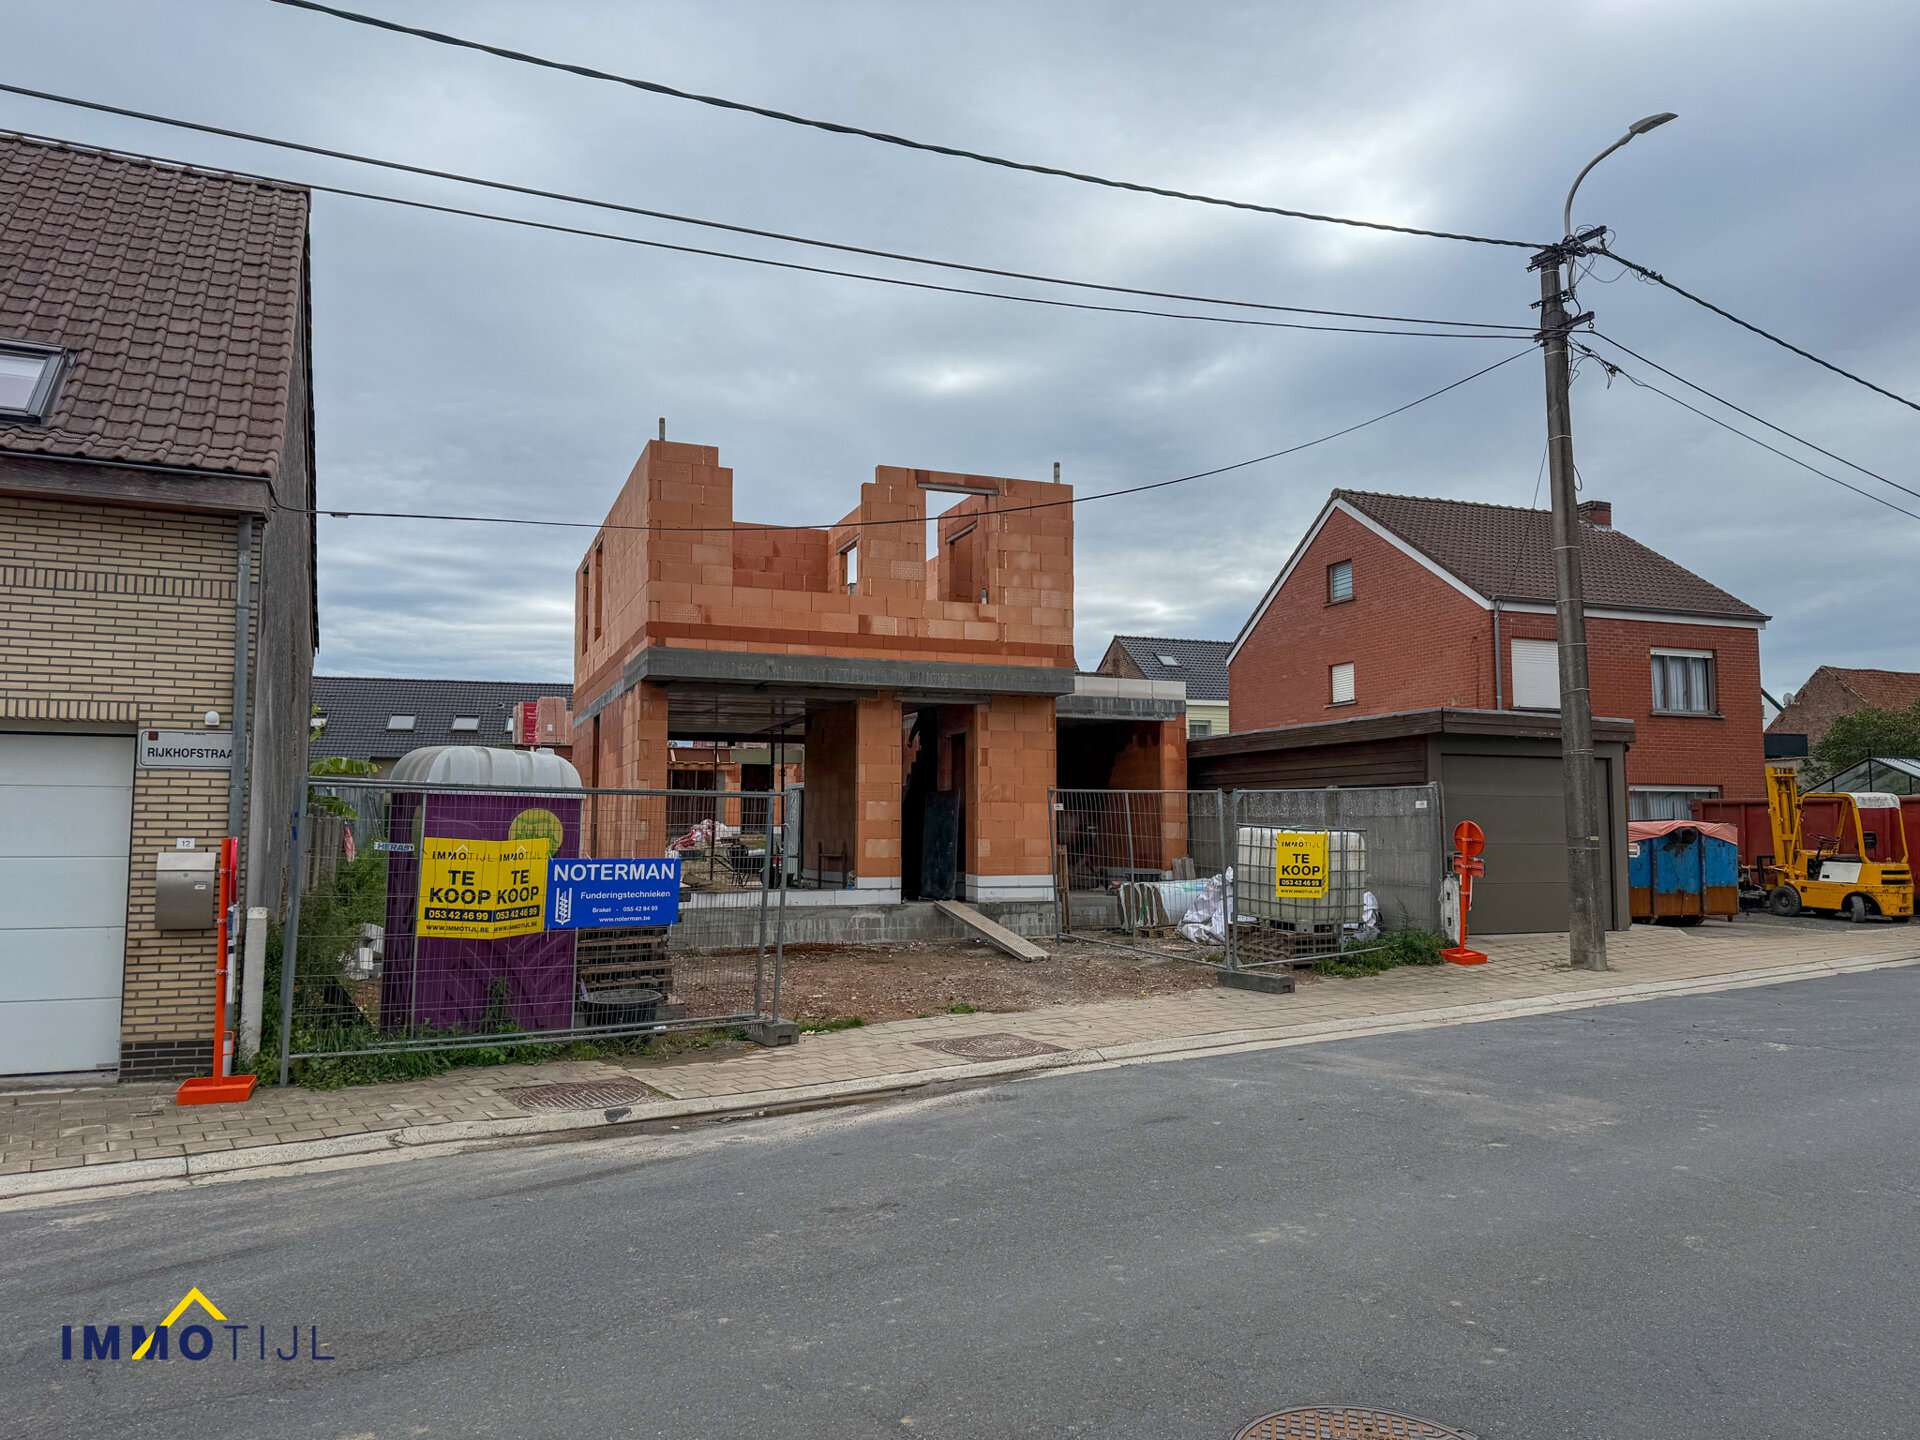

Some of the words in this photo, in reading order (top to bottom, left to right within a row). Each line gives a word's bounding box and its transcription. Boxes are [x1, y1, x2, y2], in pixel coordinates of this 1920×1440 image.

[147, 747, 233, 759] RIJKHOFSTRAA
[432, 850, 495, 863] IMMOTIJL
[1292, 853, 1310, 864] TE
[553, 863, 675, 882] NOTERMAN
[1281, 865, 1321, 876] KOOP
[448, 870, 475, 886] TE
[510, 869, 530, 886] TE
[429, 887, 492, 905] KOOP
[497, 886, 539, 905] KOOP
[580, 890, 671, 901] Funderingstechnieken
[428, 909, 447, 919] 053
[448, 910, 461, 919] 42
[462, 911, 475, 920] 46
[476, 912, 489, 921] 99
[495, 911, 510, 920] 053
[510, 909, 519, 918] 42
[519, 908, 528, 917] 46
[528, 907, 538, 916] 99
[425, 923, 490, 933] WWW.IMMOTIJL.BE
